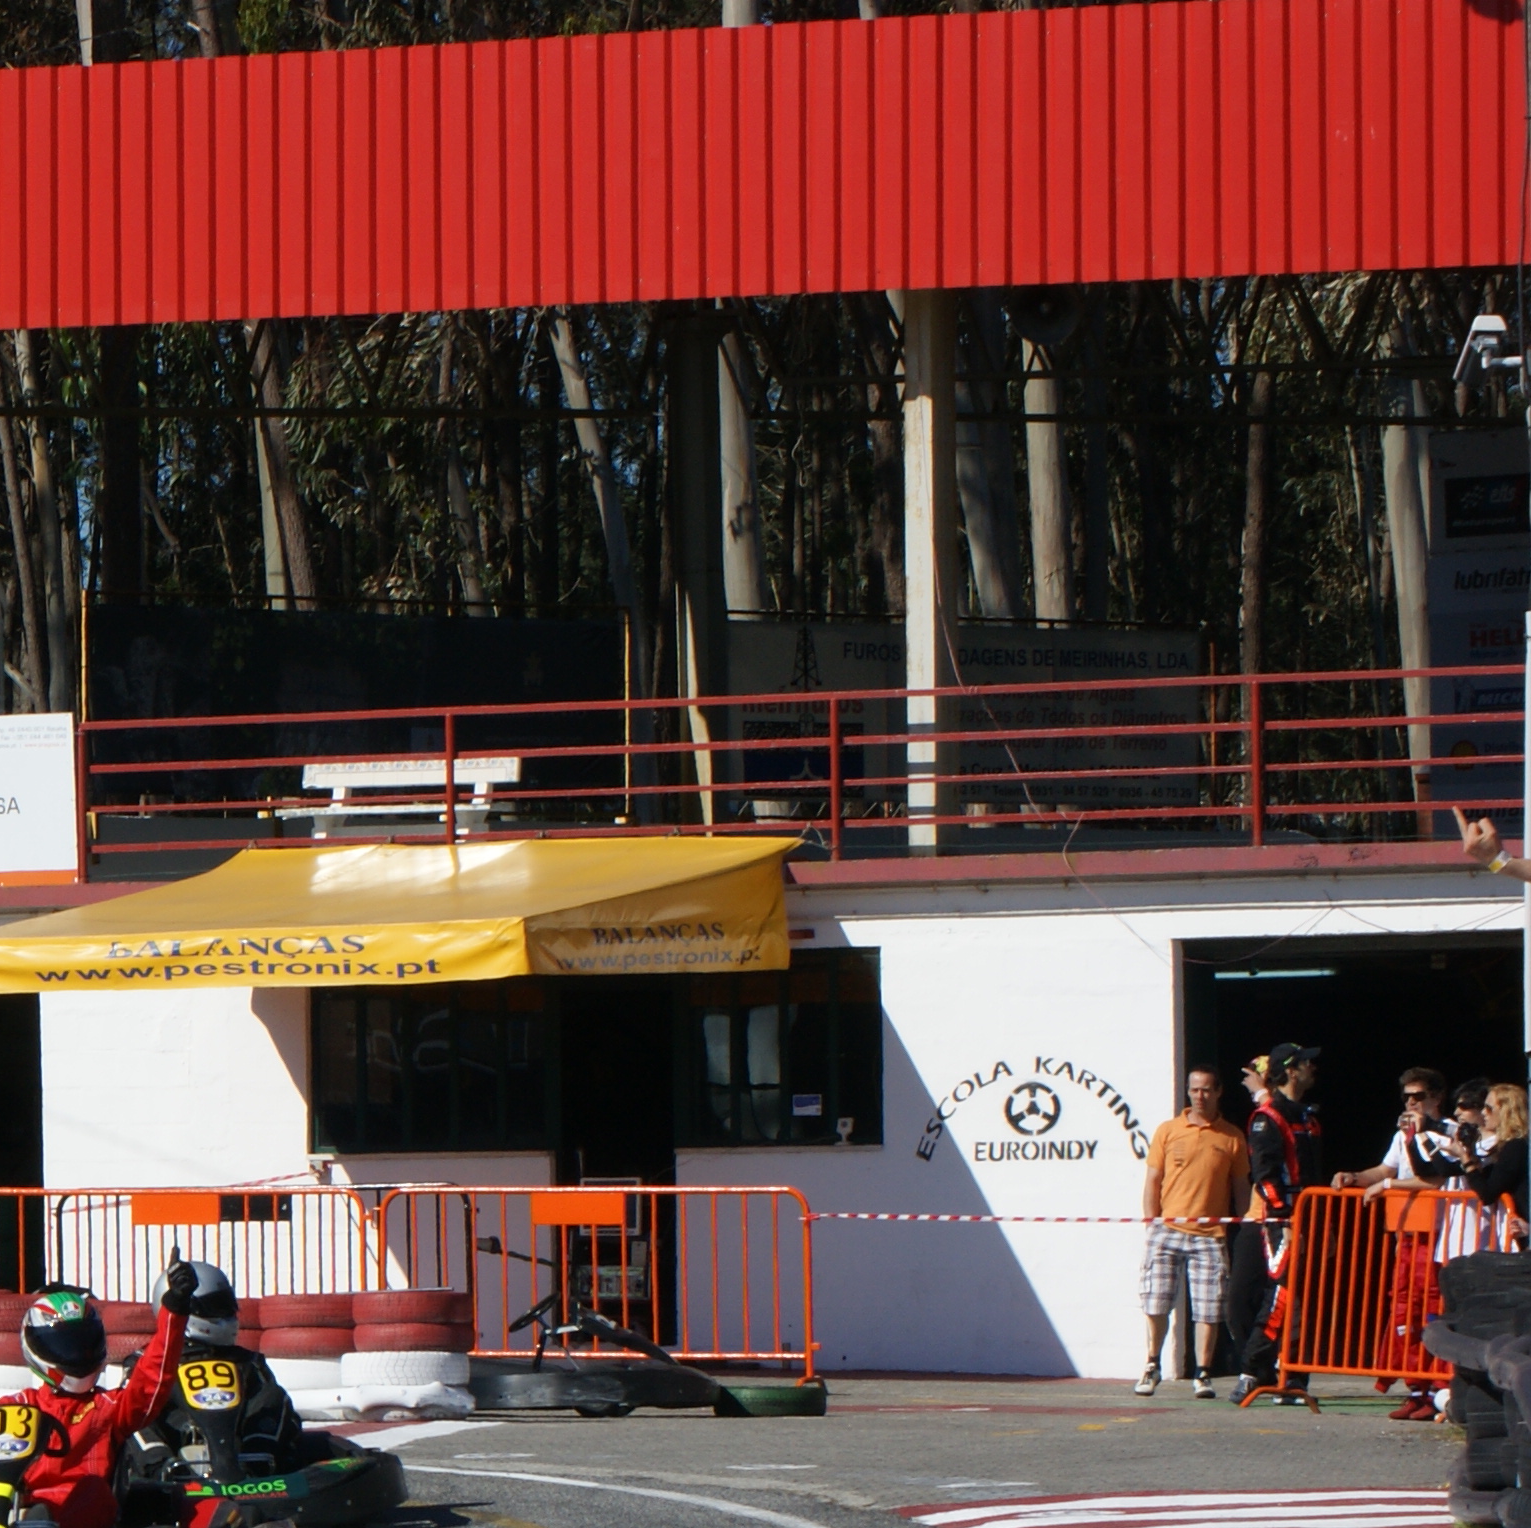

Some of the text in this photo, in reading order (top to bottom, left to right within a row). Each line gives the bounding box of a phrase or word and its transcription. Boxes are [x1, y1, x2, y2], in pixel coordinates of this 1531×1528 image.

[843, 641, 901, 662] FUROS
[1032, 649, 1054, 667] DE
[592, 922, 726, 947] BALANÇAS
[35, 957, 442, 983] www.pestronix.pt
[915, 1056, 1152, 1162] ESCOLA KARTING
[974, 1140, 1099, 1162] EUROINDY
[185, 1362, 235, 1391] 89
